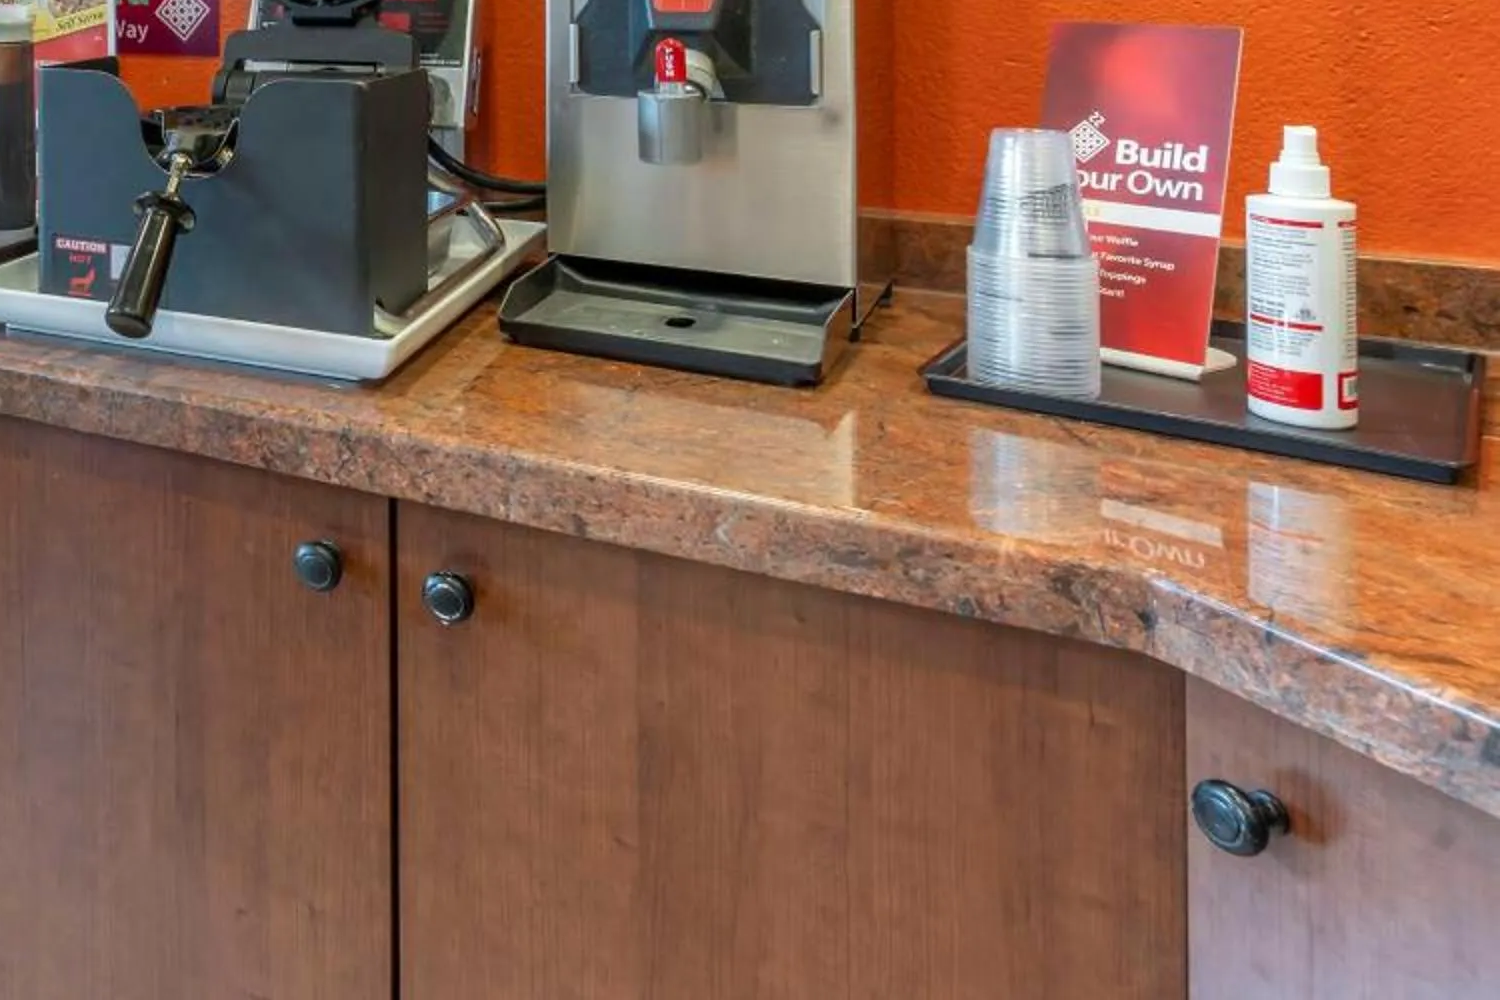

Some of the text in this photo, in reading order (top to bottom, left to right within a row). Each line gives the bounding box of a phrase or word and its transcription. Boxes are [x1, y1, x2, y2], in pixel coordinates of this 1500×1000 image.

[1115, 138, 1209, 173] Build
[1076, 168, 1204, 201] our Own
[55, 236, 107, 255] CAUTION
[1143, 256, 1175, 272] Syrup
